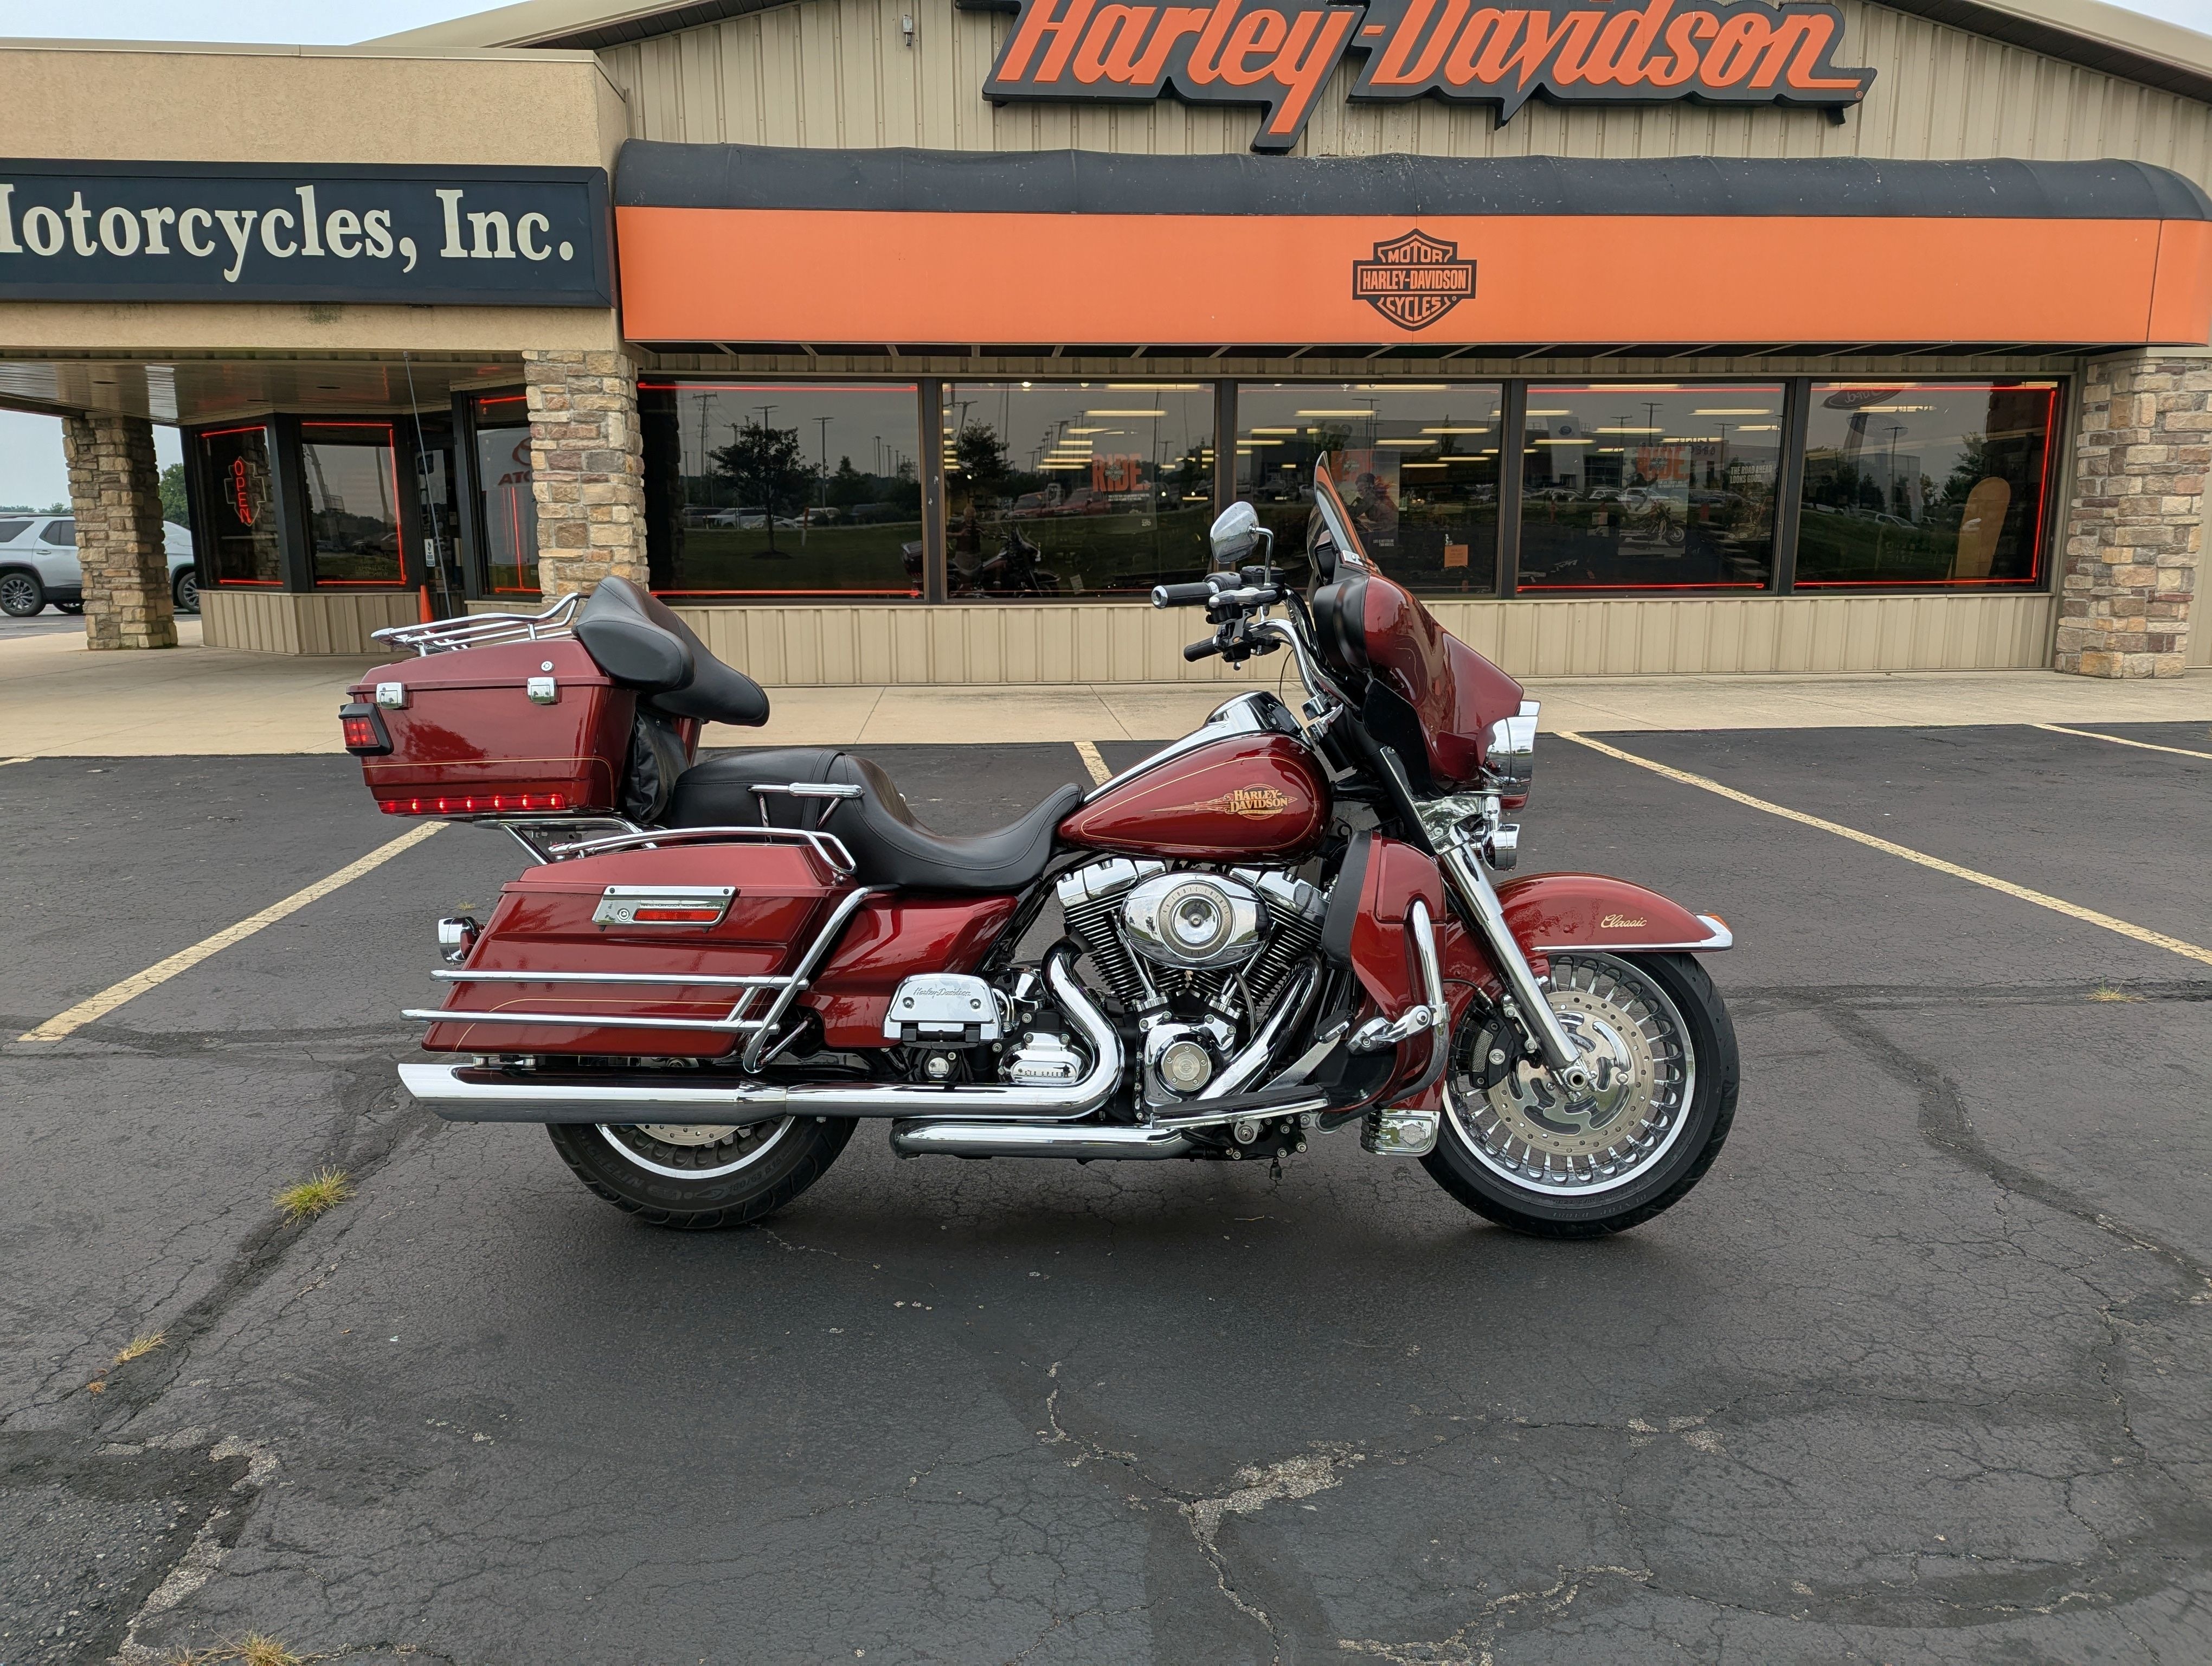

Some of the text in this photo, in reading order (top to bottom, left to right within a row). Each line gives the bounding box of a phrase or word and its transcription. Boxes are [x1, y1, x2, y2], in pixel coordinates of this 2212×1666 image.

[995, 0, 1862, 134] Harley-Davidson
[435, 189, 574, 261] Inc.
[1388, 240, 1443, 263] MOTOR
[1362, 270, 1467, 290] HARLEY-DAVIDSON
[1386, 297, 1441, 322] CYCLES
[1731, 465, 1772, 475] THE ROAD AHEAD
[1730, 475, 1746, 484] LOOKS
[234, 460, 252, 523] OPEN
[1233, 790, 1283, 801] HARLEY-
[1230, 797, 1288, 812] DAVIDSON
[1600, 914, 1647, 928] Classic
[913, 987, 972, 999] Harley-Davidson
